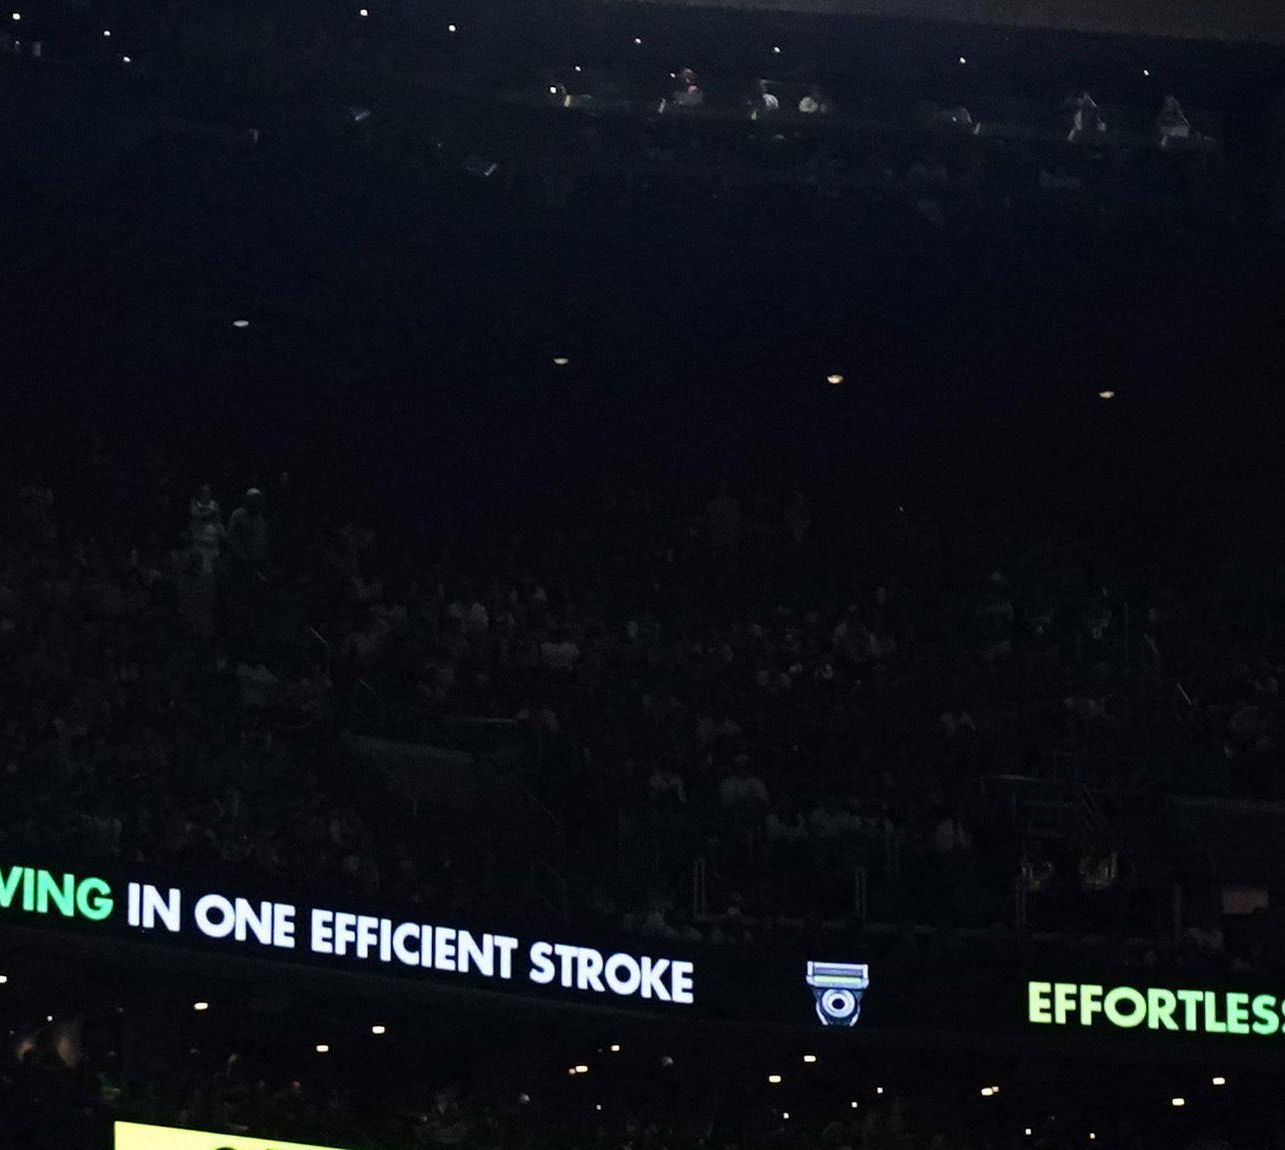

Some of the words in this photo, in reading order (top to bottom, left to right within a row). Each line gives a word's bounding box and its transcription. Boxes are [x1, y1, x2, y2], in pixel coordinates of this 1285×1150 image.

[128, 882, 181, 932] IN
[194, 894, 295, 948] ONE
[311, 909, 518, 979] EFFICIENT
[530, 941, 694, 1003] STROKE
[1028, 981, 1285, 1035] EFFORTLES
